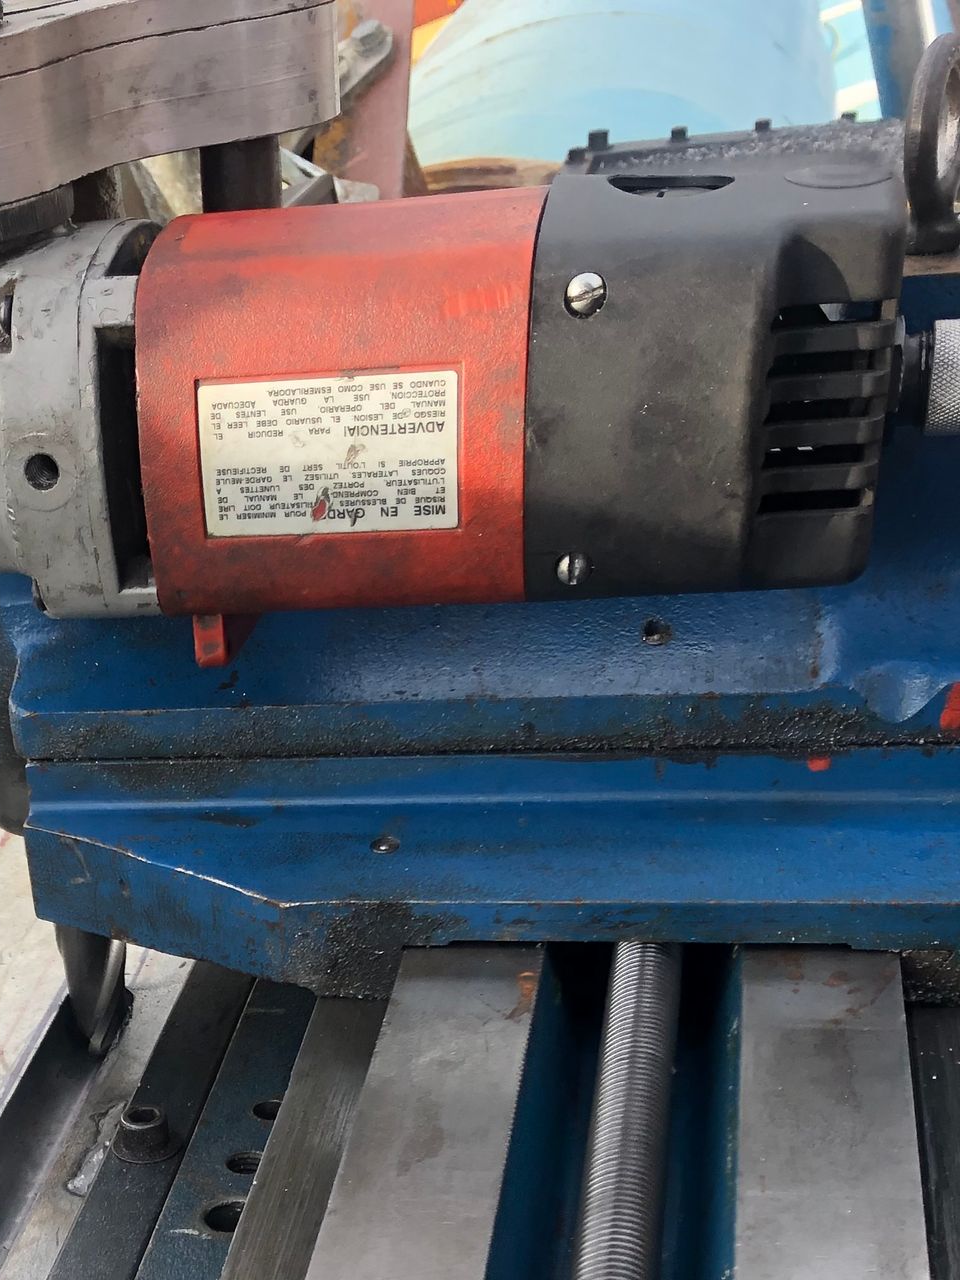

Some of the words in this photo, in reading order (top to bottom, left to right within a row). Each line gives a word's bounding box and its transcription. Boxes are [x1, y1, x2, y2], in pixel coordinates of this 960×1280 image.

[338, 384, 363, 392] COMO
[410, 380, 446, 388] CUANDO
[272, 398, 306, 406] GUARDA
[324, 396, 334, 404] LA
[353, 394, 370, 402] USE
[211, 400, 256, 410] ADECUADA
[379, 402, 396, 410] DEL
[410, 400, 446, 408] MANUAL
[210, 412, 221, 420] DE
[236, 410, 266, 418] LENTES
[280, 408, 296, 416] USE
[392, 412, 403, 420] DE
[414, 410, 446, 418] RIESGO
[226, 421, 248, 429] LEER
[256, 420, 278, 428] DEBE
[286, 416, 322, 426] USUARIO
[211, 422, 221, 430] EL
[248, 430, 284, 438] REDUCIR
[308, 427, 330, 435] PARA
[336, 462, 366, 470] L'OUTIL
[378, 460, 386, 468] SI
[398, 458, 446, 467] APPROPRIE
[302, 464, 323, 472] SERT
[412, 468, 446, 476] COQUES
[216, 476, 272, 485] GARDE-MEULE
[282, 474, 292, 482] LE
[304, 473, 339, 481] UTILISEZ
[240, 485, 280, 494] LUNETTES
[397, 488, 416, 496] BIEN
[217, 496, 228, 504] DE
[244, 494, 277, 502] MANUAL
[340, 498, 386, 506] BLESSURES
[414, 496, 445, 504] RISQUE
[323, 508, 365, 519] GARD
[380, 506, 398, 517] EN
[414, 505, 446, 516] MISE
[236, 512, 276, 520] MINIMISER
